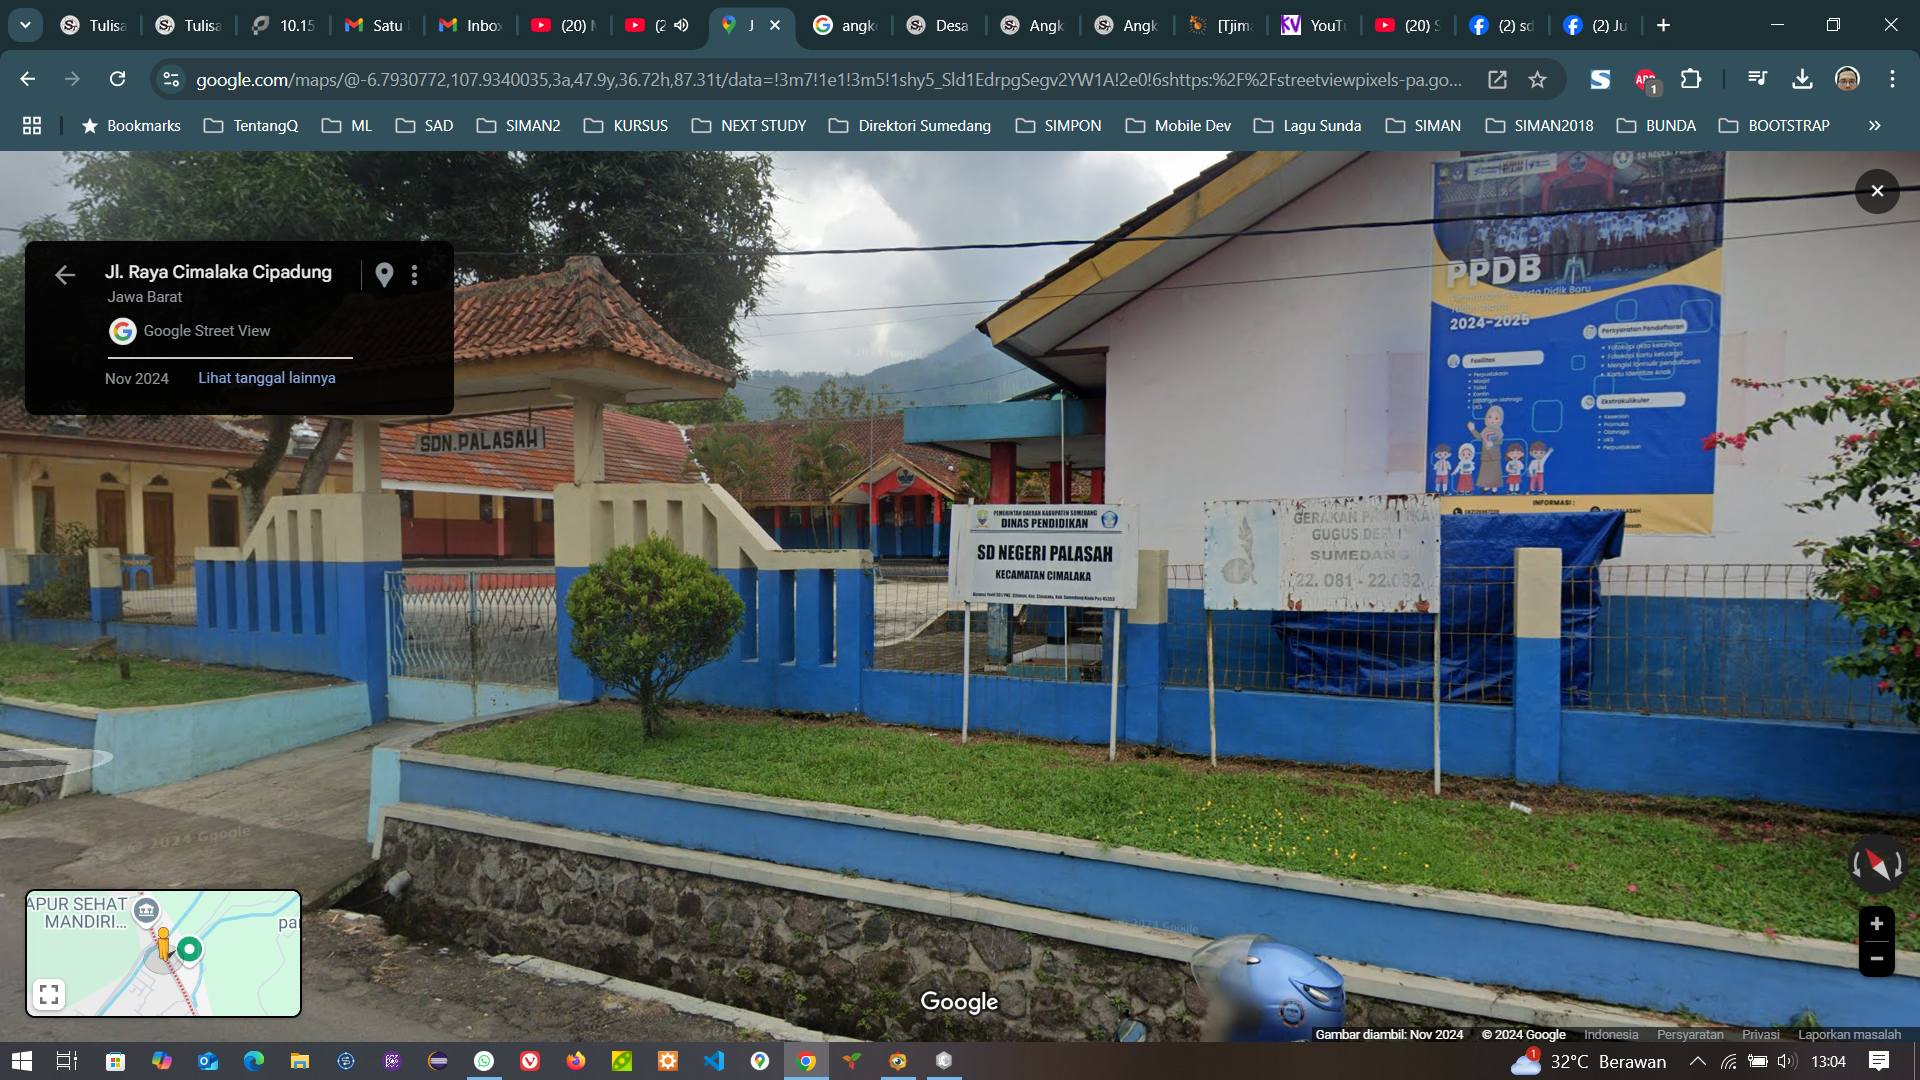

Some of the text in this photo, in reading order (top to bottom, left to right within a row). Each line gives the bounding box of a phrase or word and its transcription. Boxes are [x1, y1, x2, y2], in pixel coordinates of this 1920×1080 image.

[373, 19, 403, 32] Satu
[561, 19, 587, 34] (20)
[936, 19, 969, 32] Desa
[1029, 19, 1065, 35] Angk
[1123, 19, 1159, 35] Angk
[1405, 19, 1431, 34] (20)
[1498, 19, 1516, 34] (2)
[1592, 19, 1610, 34] (2)
[107, 119, 182, 133] Bookmarks
[233, 119, 300, 135] TentangQ
[351, 119, 373, 132] ML
[424, 119, 454, 132] SAD
[506, 119, 561, 132] SIMAN2
[614, 119, 669, 132] KURSUS
[721, 119, 807, 132] NEXT STUDY
[859, 119, 992, 135] Direktori Sumedang
[1044, 119, 1103, 132] SIMPON
[1155, 119, 1232, 132] Mobile Dev
[1284, 119, 1362, 135] Lagu Sunda
[1415, 119, 1462, 132] SIMAN
[1514, 119, 1594, 132] SIMAN2018
[1646, 119, 1697, 132] BUNDA
[1749, 119, 1831, 132] BOOTSTRAP
[1446, 253, 1542, 289] PPDB
[1450, 313, 1530, 331] 2024-2025
[993, 509, 1098, 517] PEMERINTAH DAERAH KABUPATEN SUMEDANG
[1001, 518, 1089, 529] DINAS PENDIDIKAN
[1311, 528, 1359, 541] GUGUS
[977, 544, 1113, 563] SD NEGERI PALASAH
[1310, 549, 1410, 561] SUMEDANG
[995, 569, 1092, 582] KECAMATAN CIMALAKA
[1551, 1054, 1667, 1069] 32°C Berawan
[1811, 1055, 1847, 1068] 13:04
